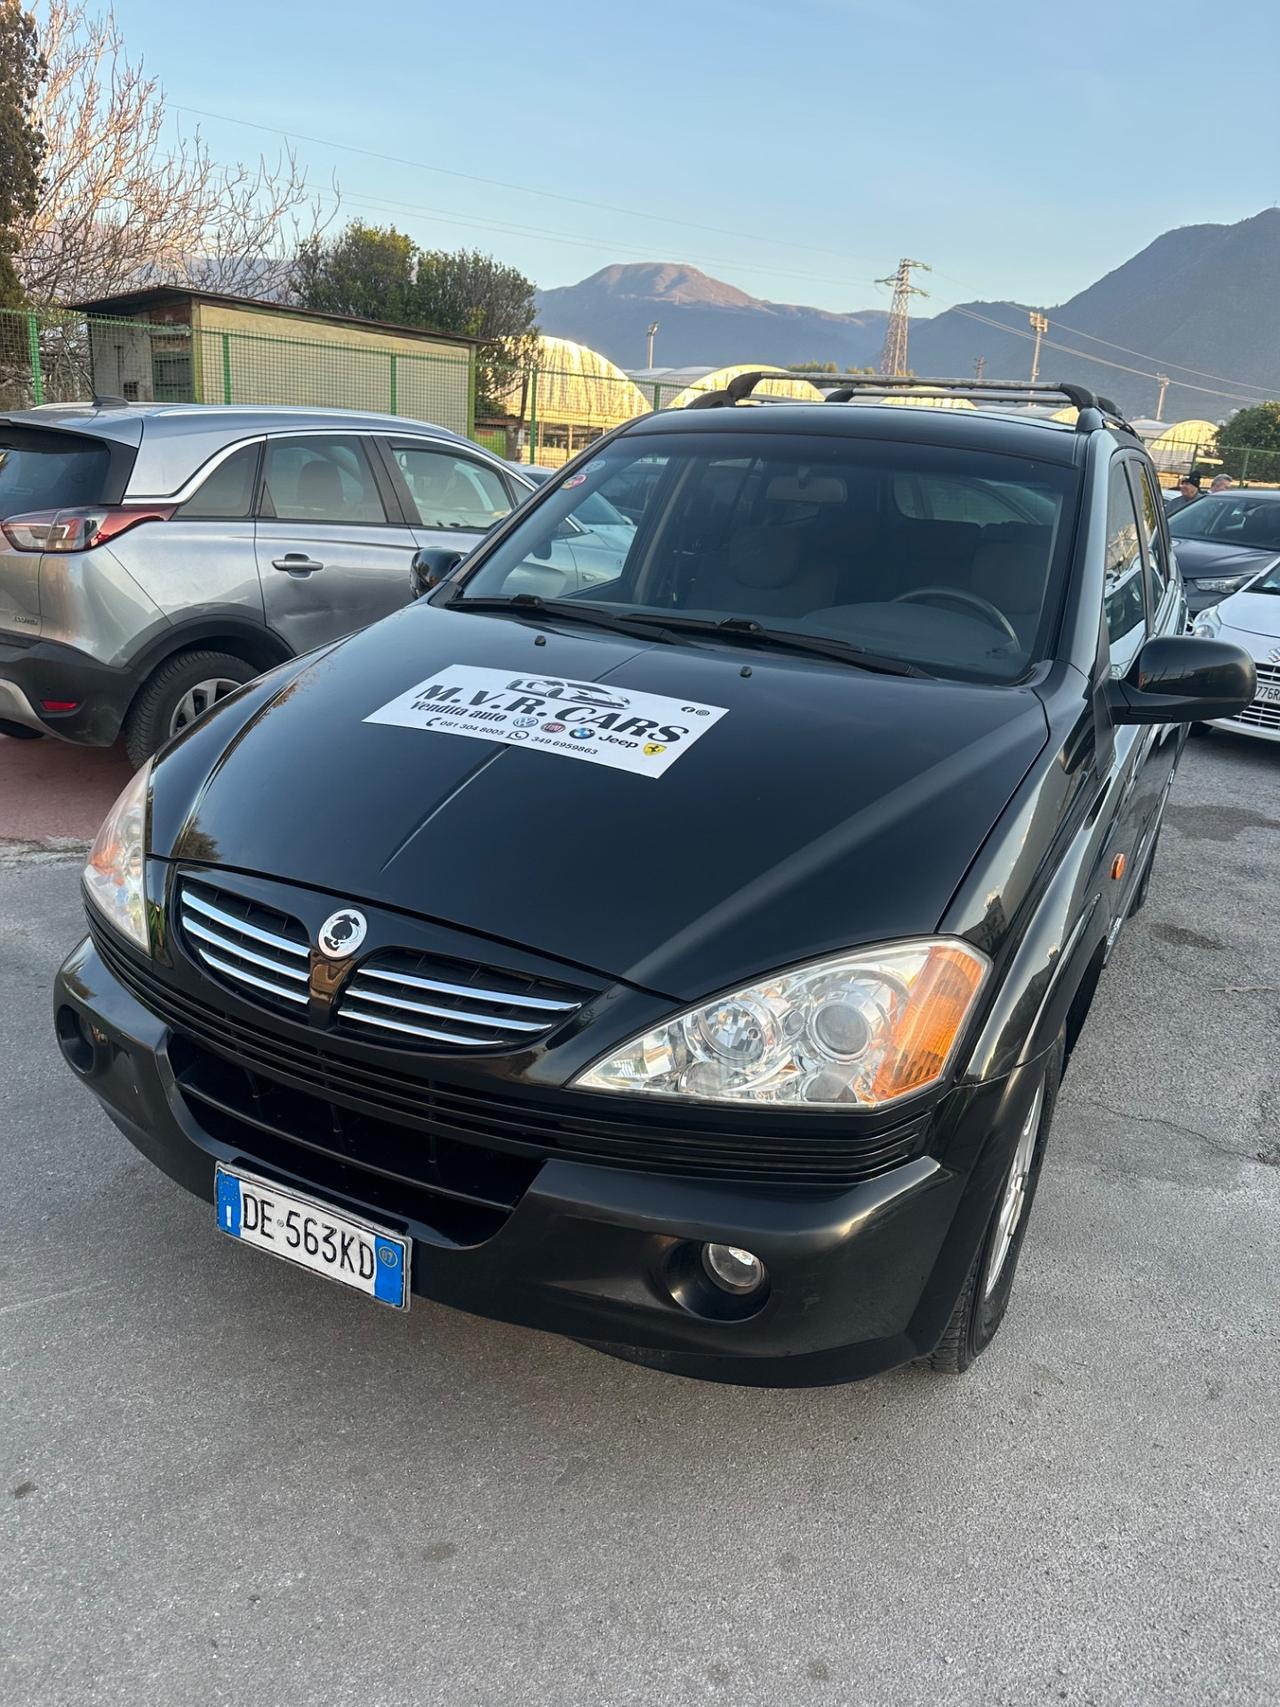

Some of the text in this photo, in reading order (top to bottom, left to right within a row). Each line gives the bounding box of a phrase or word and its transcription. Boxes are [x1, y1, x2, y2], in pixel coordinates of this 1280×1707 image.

[410, 701, 507, 722] Vendita auto
[415, 685, 689, 743] M.V.R. CARS
[440, 720, 506, 736] 081 304 8005
[531, 736, 598, 755] 349 6959863
[598, 735, 639, 749] Jeep
[243, 1193, 274, 1239] DE
[286, 1210, 375, 1280] 563KD
